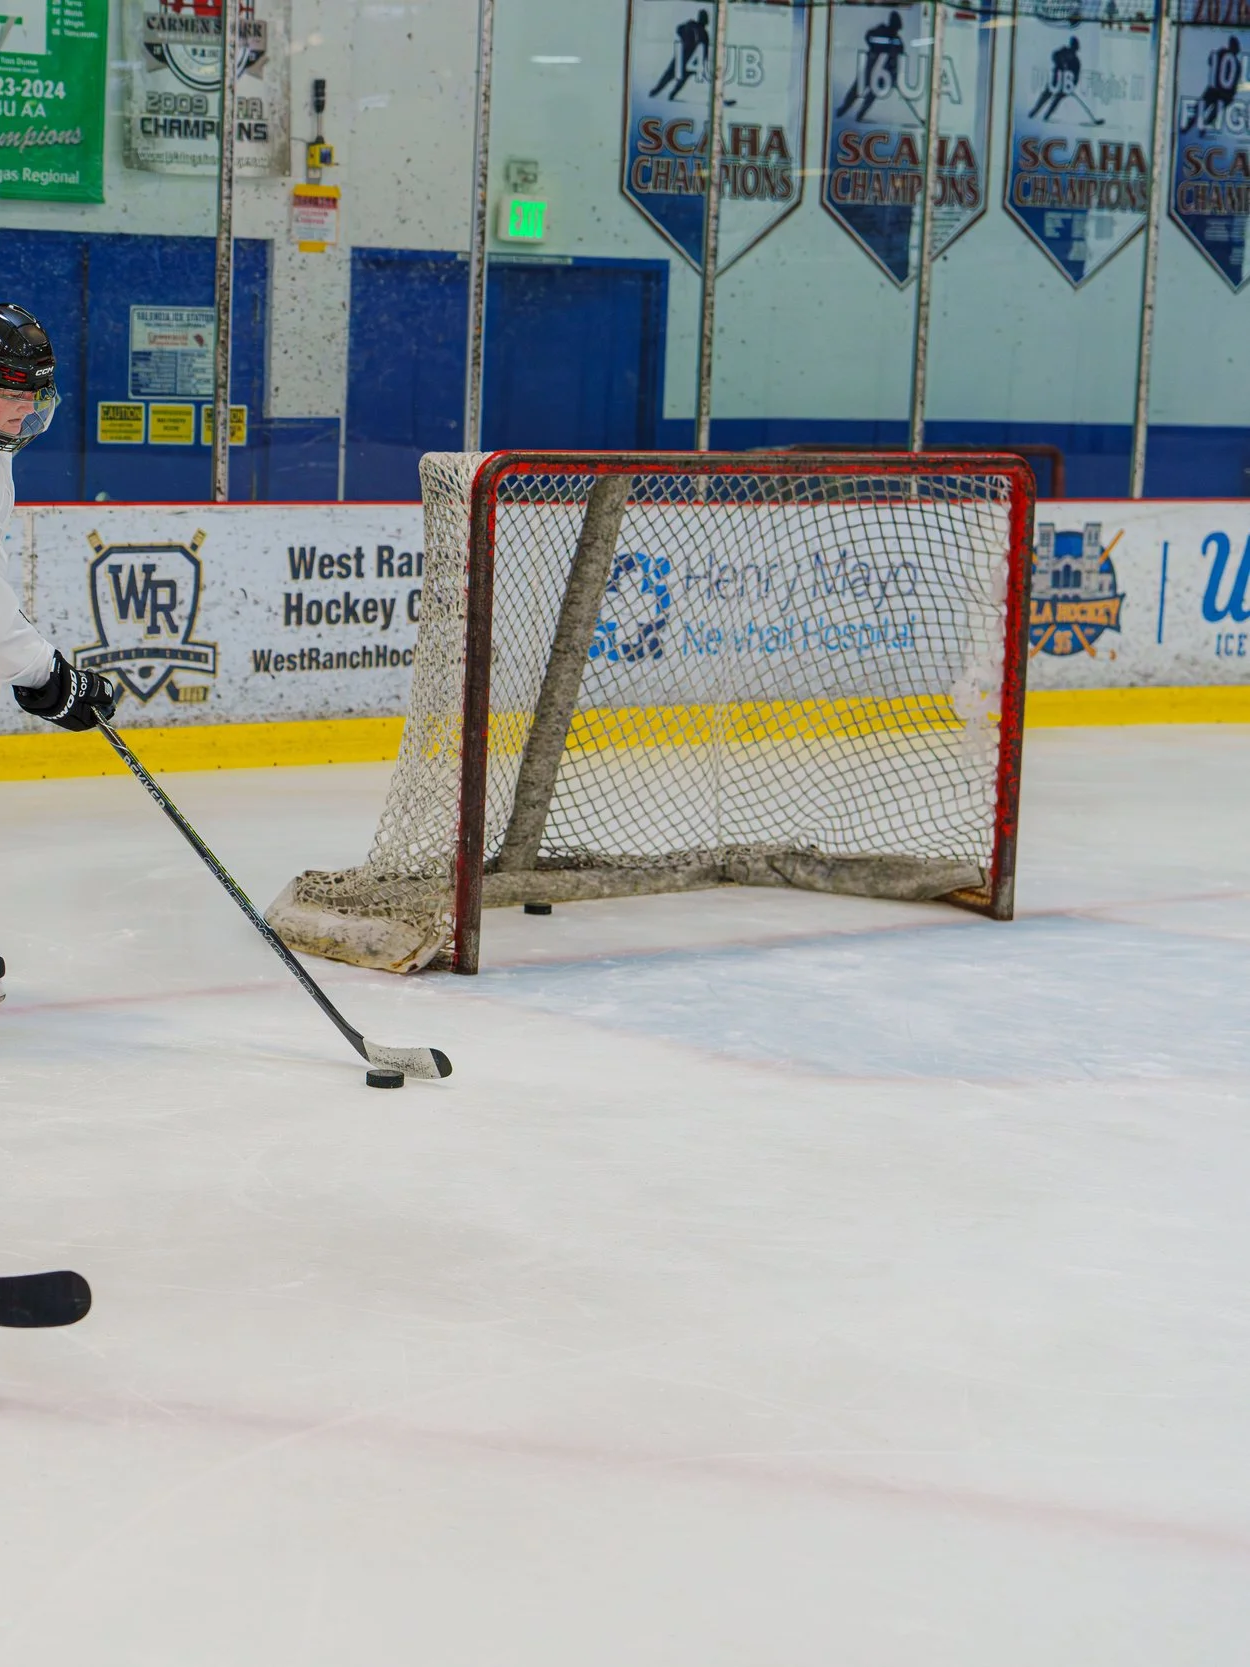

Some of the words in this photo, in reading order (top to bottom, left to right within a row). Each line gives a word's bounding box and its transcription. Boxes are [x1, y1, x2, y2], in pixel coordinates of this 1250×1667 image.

[147, 16, 209, 33] CARMEN
[20, 101, 47, 119] AA
[1180, 98, 1250, 135] FLIG
[140, 117, 269, 142] CHAMPINS
[1018, 135, 1149, 174] SCAHA
[22, 167, 80, 185] Regional
[830, 168, 980, 208] CHAMPONS
[35, 366, 54, 377] CCM
[287, 546, 365, 580] West
[685, 553, 801, 612] Henry
[812, 548, 918, 609] Mayo
[283, 591, 397, 631] Hockey
[803, 613, 917, 656] Hospital
[1216, 634, 1247, 657] ICE
